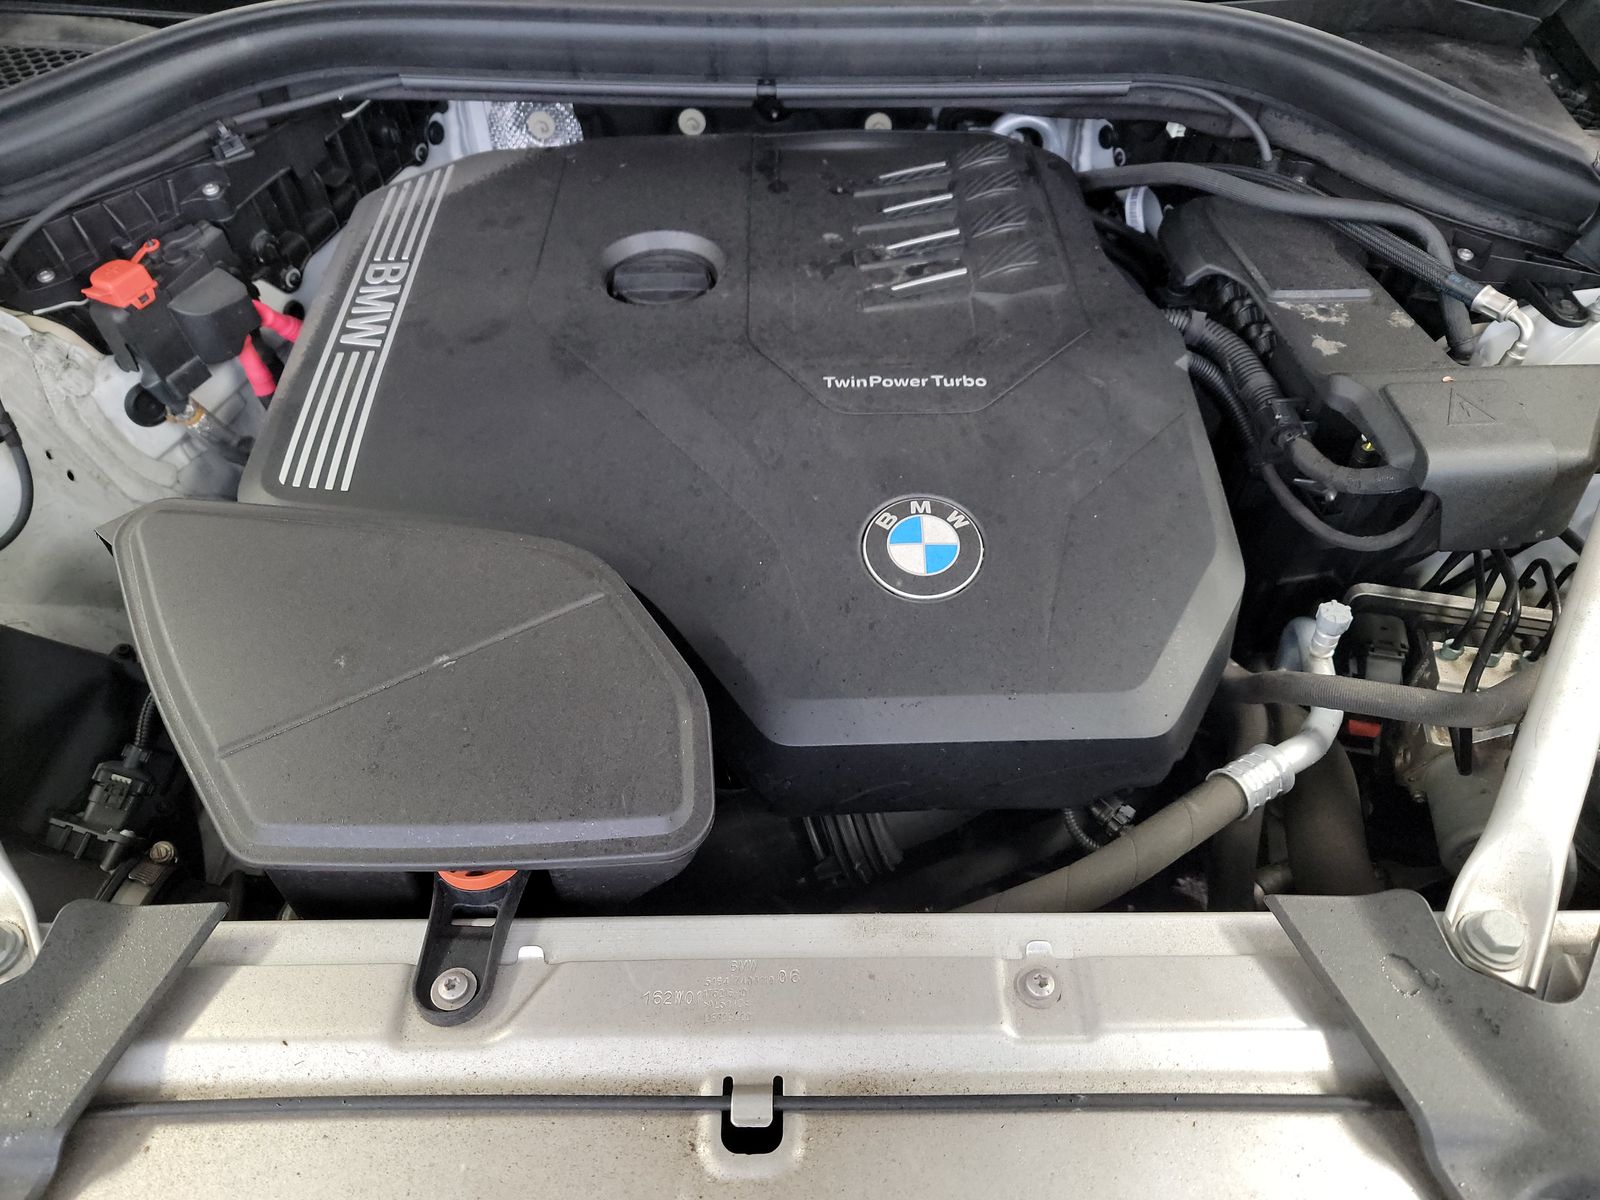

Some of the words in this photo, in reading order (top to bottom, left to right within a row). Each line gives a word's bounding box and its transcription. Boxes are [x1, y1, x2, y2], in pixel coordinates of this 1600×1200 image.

[340, 262, 410, 347] BMW
[930, 374, 988, 388] Turbo
[875, 500, 970, 531] BMW
